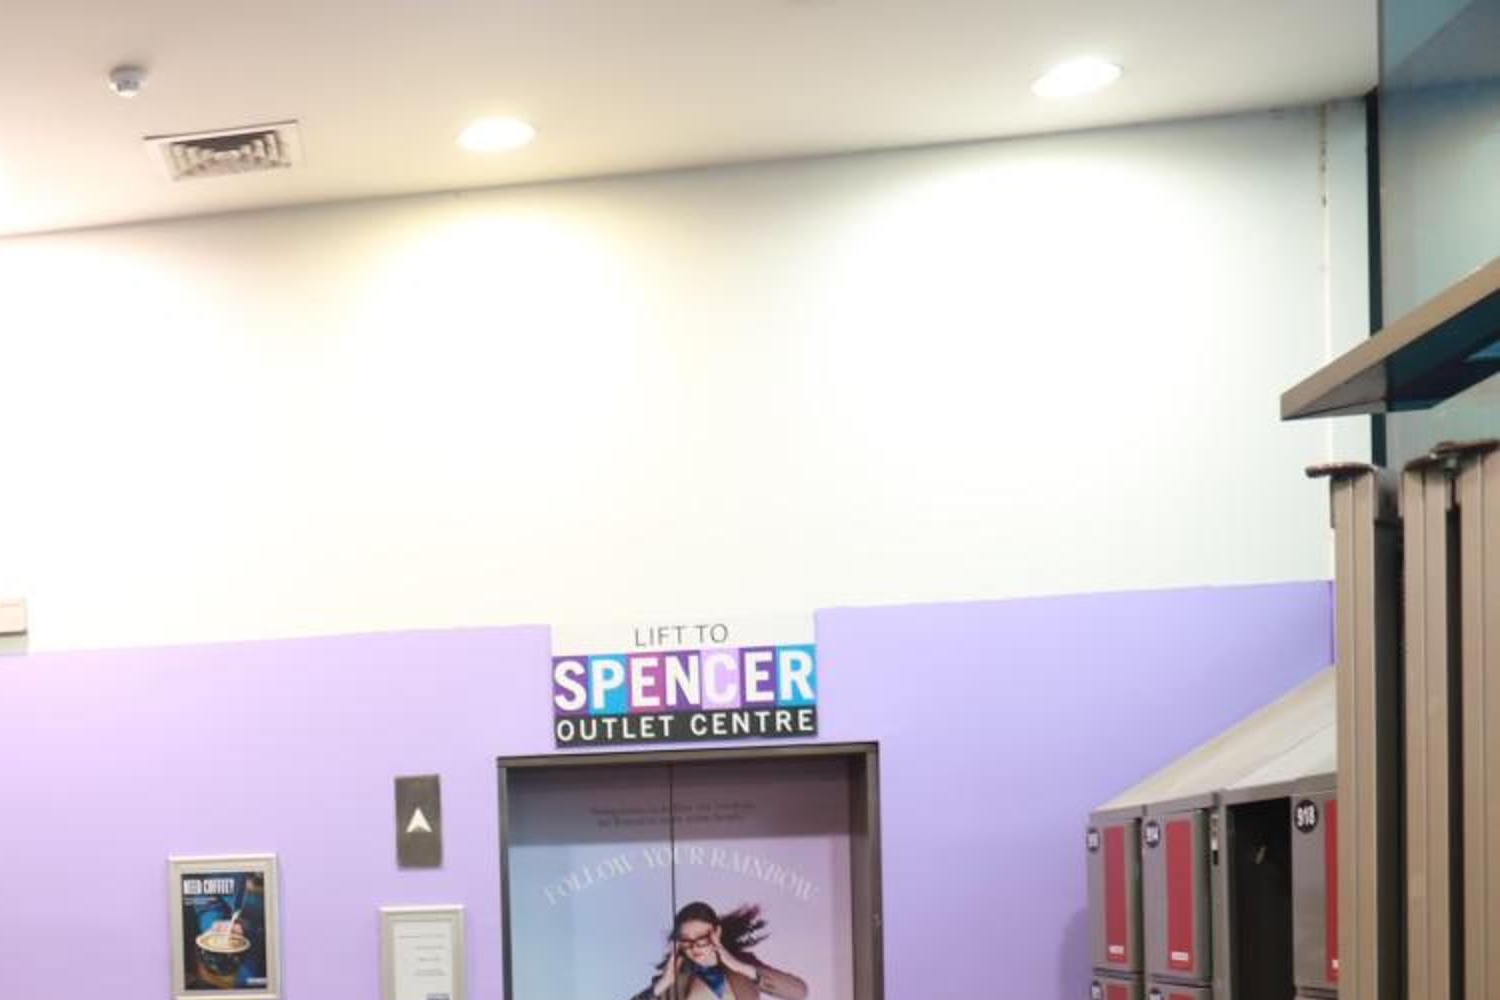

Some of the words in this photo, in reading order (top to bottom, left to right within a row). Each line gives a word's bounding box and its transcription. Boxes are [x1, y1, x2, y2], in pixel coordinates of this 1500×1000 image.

[634, 625, 687, 647] LIFT
[696, 624, 729, 643] TO
[553, 650, 816, 711] SPENCER
[557, 715, 673, 742] OUTLET
[690, 709, 815, 736] CENTRE
[542, 852, 634, 905] FOLLOW
[644, 846, 706, 869] YOUR
[710, 847, 821, 902] RAINBOW
